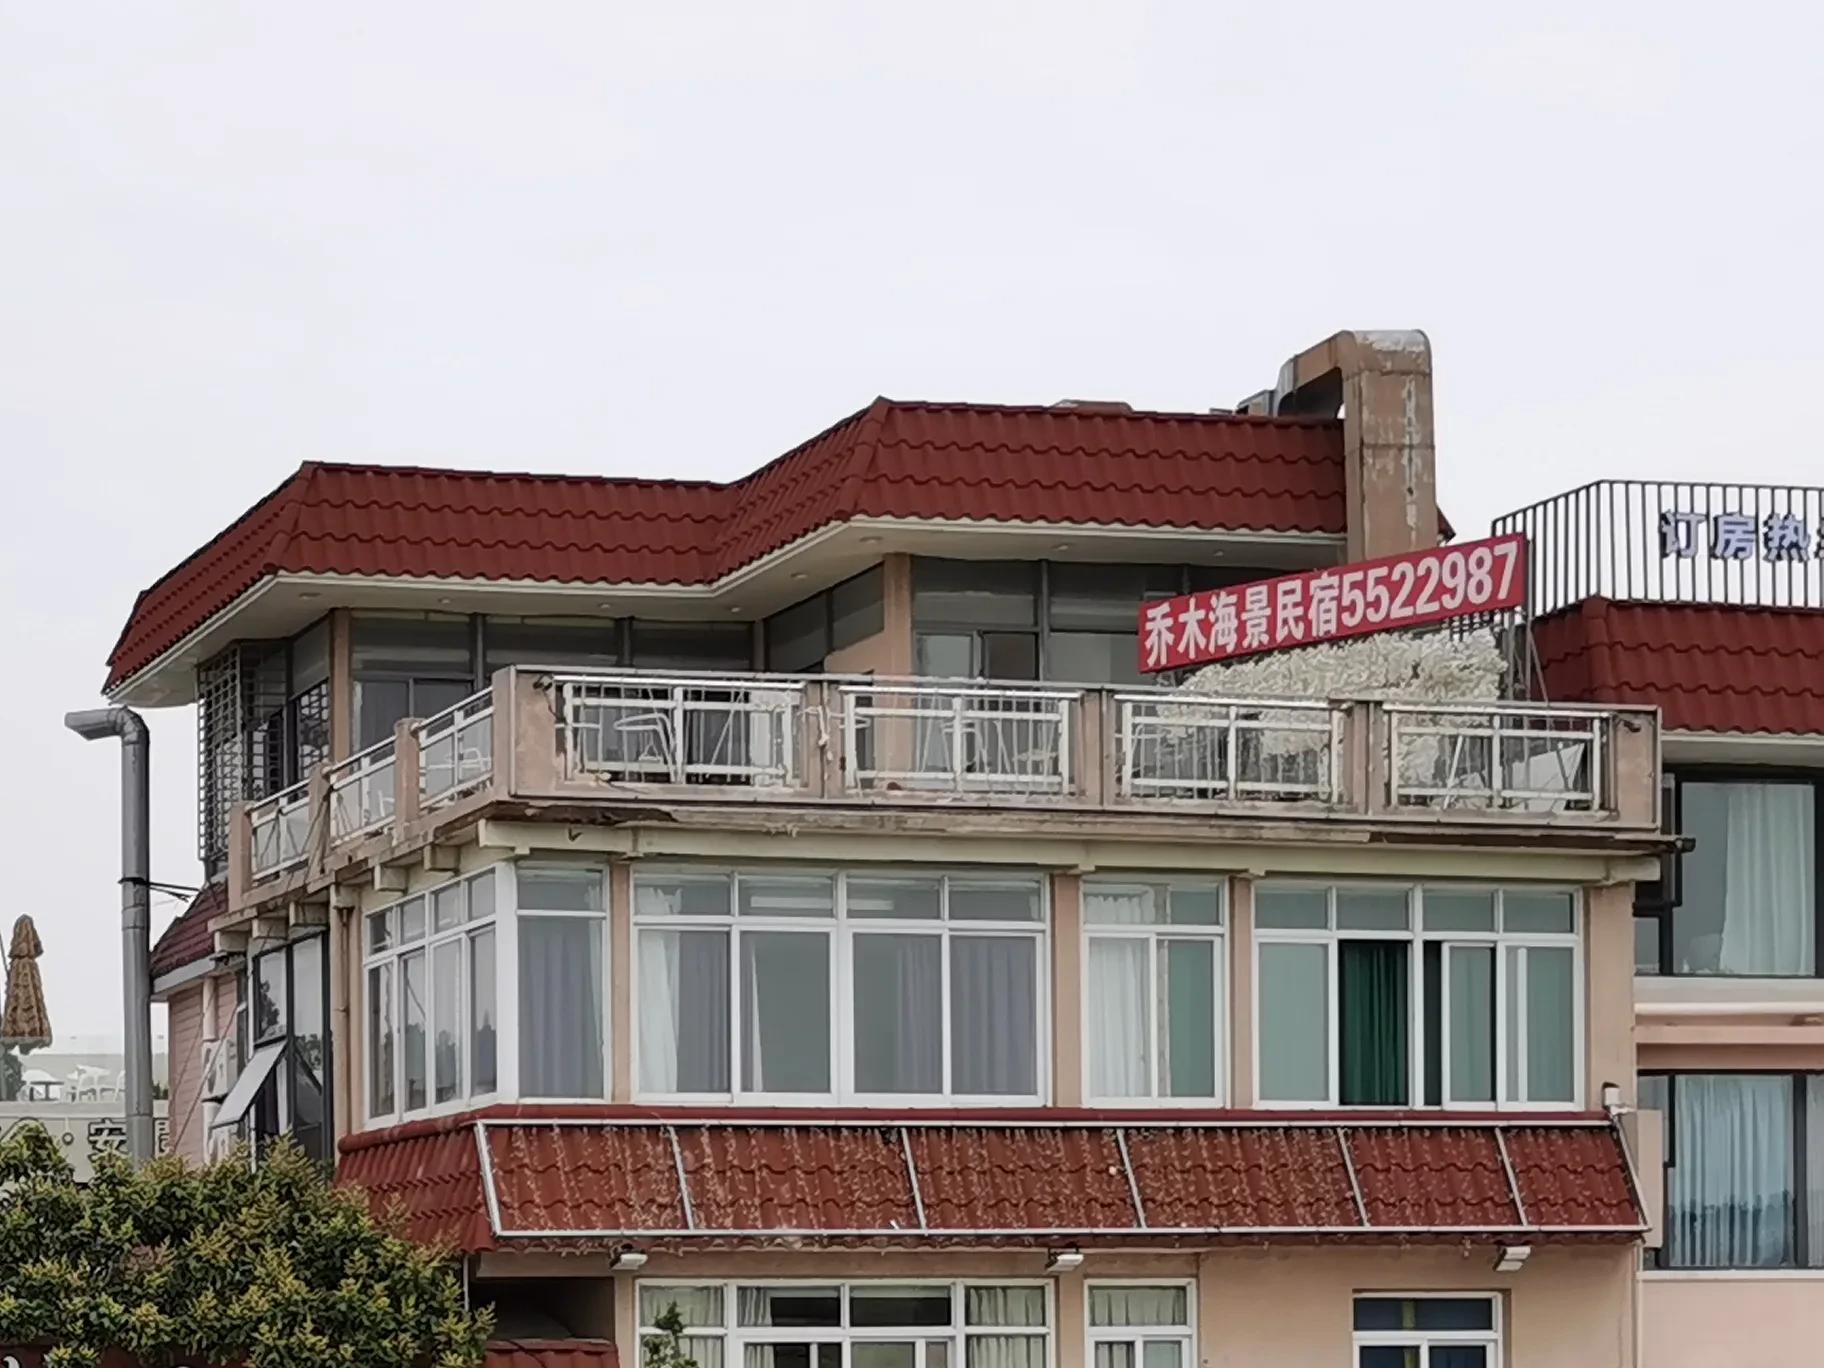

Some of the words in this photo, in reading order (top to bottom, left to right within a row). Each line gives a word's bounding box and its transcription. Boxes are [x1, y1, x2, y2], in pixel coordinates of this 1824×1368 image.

[1660, 508, 1824, 564] 订房热
[1145, 541, 1519, 668] 乔木海景民宿5522987
